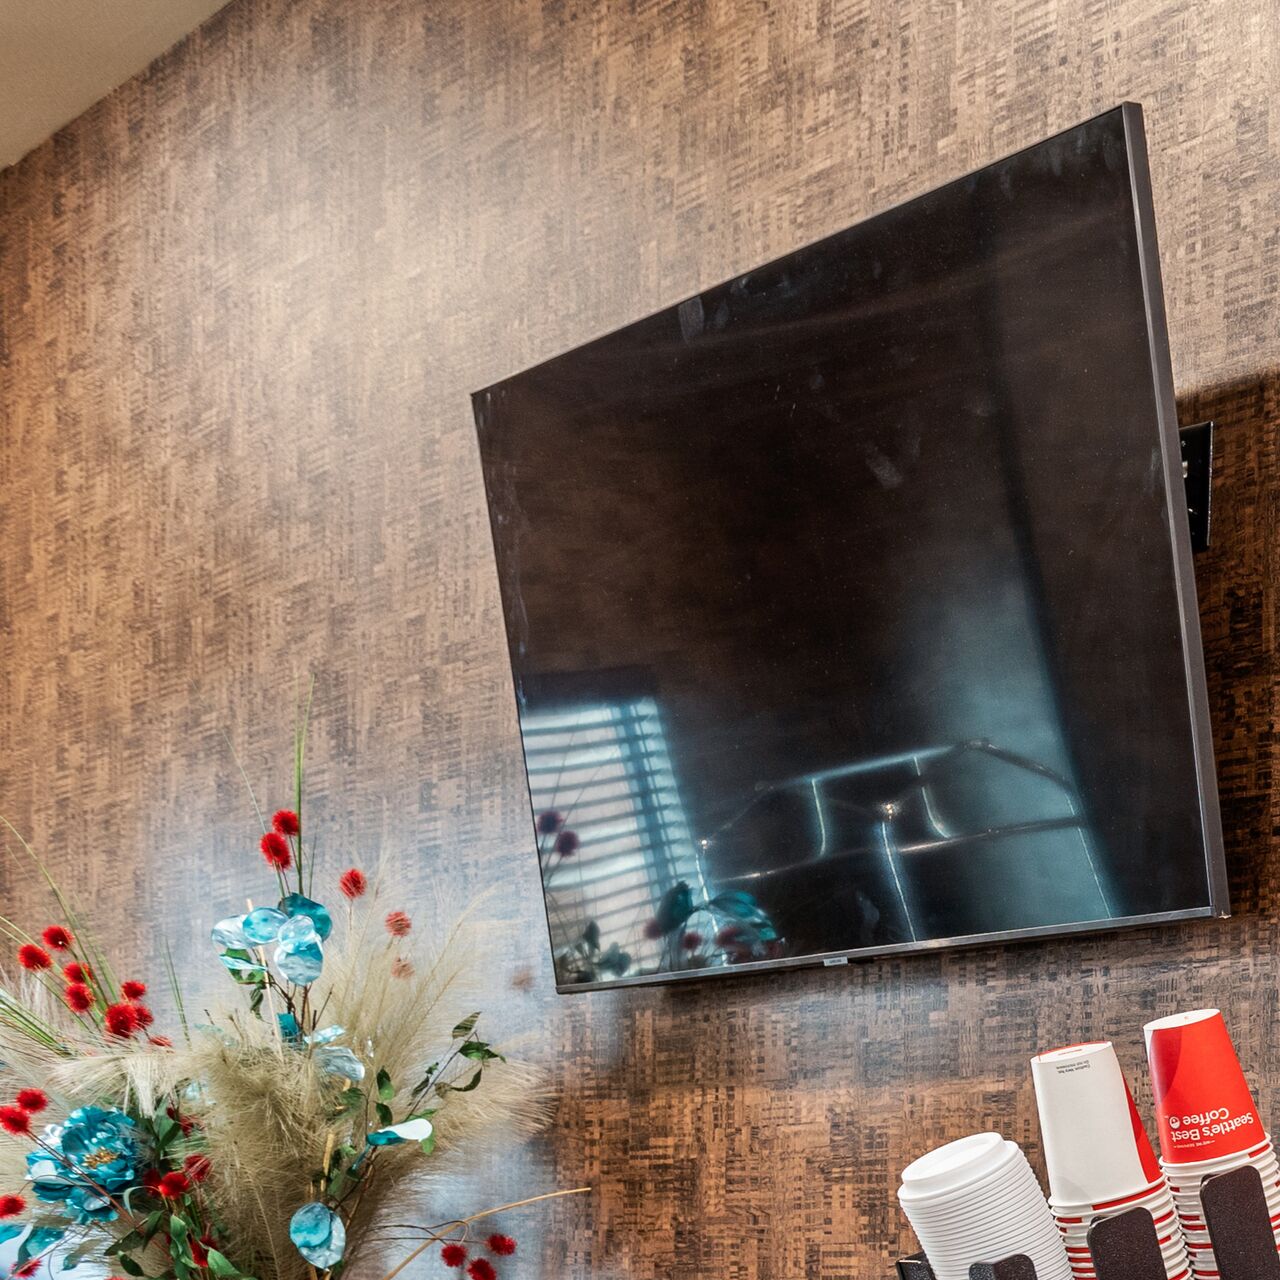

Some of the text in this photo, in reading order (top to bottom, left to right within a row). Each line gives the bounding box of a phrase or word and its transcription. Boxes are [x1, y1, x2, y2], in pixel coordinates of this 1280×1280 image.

[1171, 1112, 1254, 1142] Seattle's Best
[1182, 1107, 1229, 1126] Coffee
